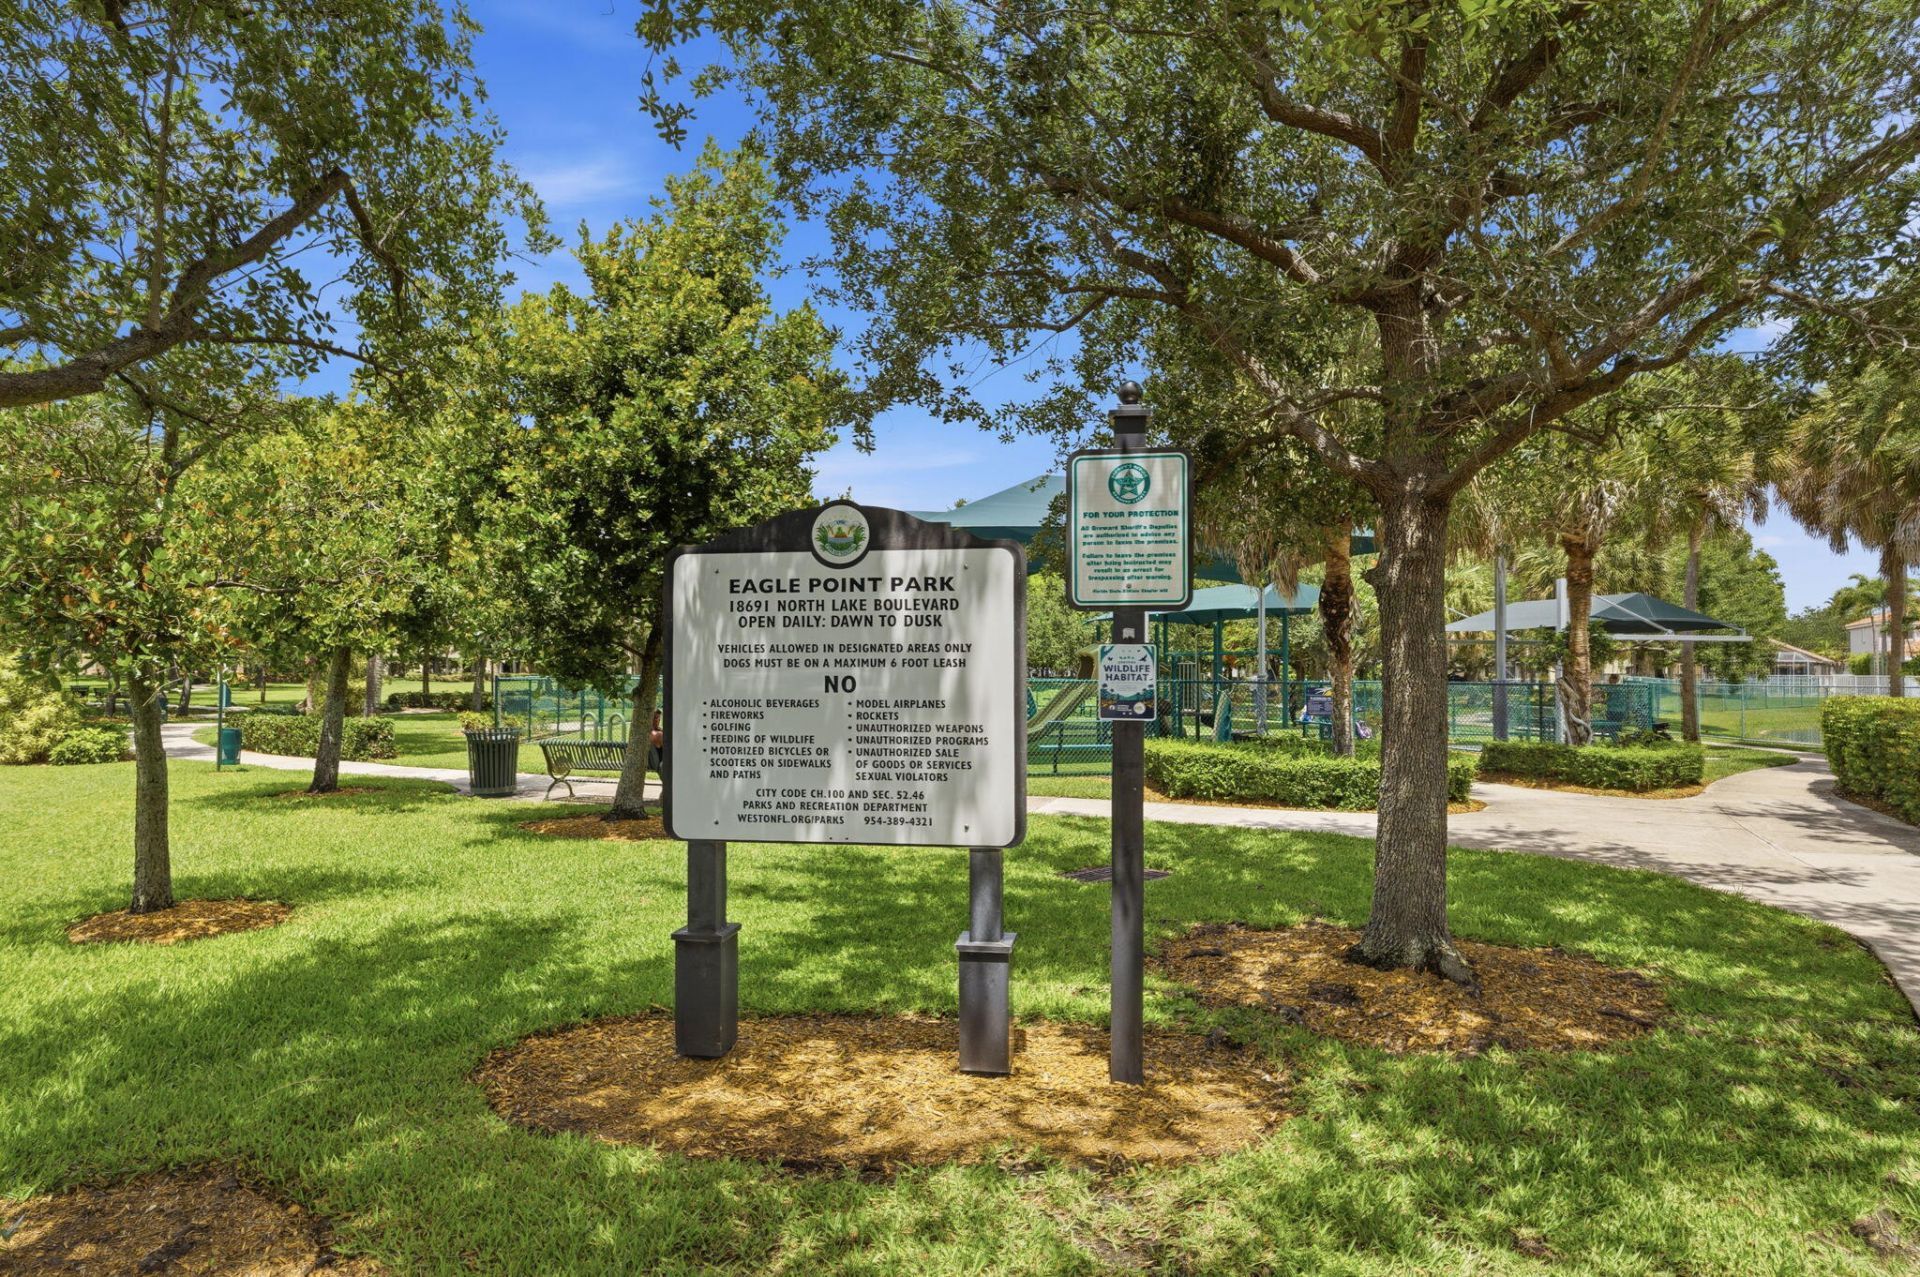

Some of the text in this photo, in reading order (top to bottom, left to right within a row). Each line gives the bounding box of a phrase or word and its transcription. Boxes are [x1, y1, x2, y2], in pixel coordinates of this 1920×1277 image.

[729, 576, 955, 594] EAGLE POINT PARK
[729, 598, 959, 612] 18691 NORTH LAKE BOULEVARD
[738, 614, 942, 628] OPEN DAILY: DAWN TO DUSK
[718, 643, 972, 654] VEHICLES ALLOWED IN DESIGNATED AREAS ONLY
[724, 658, 966, 668] DOGS MUST BE ON A MAXIMUM 6 FOOT LEASH
[824, 675, 857, 693] NO
[710, 699, 819, 708] ALCOHOLIC BEVERAGES
[856, 699, 946, 709] MODEL AIRPLANES
[711, 711, 764, 720] FIREWORKS
[856, 712, 899, 721] ROCKETS
[711, 723, 751, 732] GOLFING
[856, 724, 983, 733] UNAUTHORIZED WEAPONS
[711, 735, 815, 744] FEEDING OF WILDLIFE
[856, 736, 989, 746] UNAUTHORIZED PROGRAMS
[711, 746, 829, 756] MOTORIZED BICYCLES OR
[856, 748, 959, 758] UNAUTHORIZED SALE
[710, 758, 832, 768] SCOOTERS ON SIDEWALKS
[856, 760, 972, 770] OF GOODS OR SERVICES
[710, 770, 761, 779] AND PATHS
[856, 772, 948, 782] SEXUAL VIOLATORS
[756, 789, 924, 800] CITY CODE CH.100 AND SEC. 52.46
[743, 800, 928, 812] PARKS AND RECREATION DEPARTMENT
[864, 816, 932, 826] 954-389-4321
